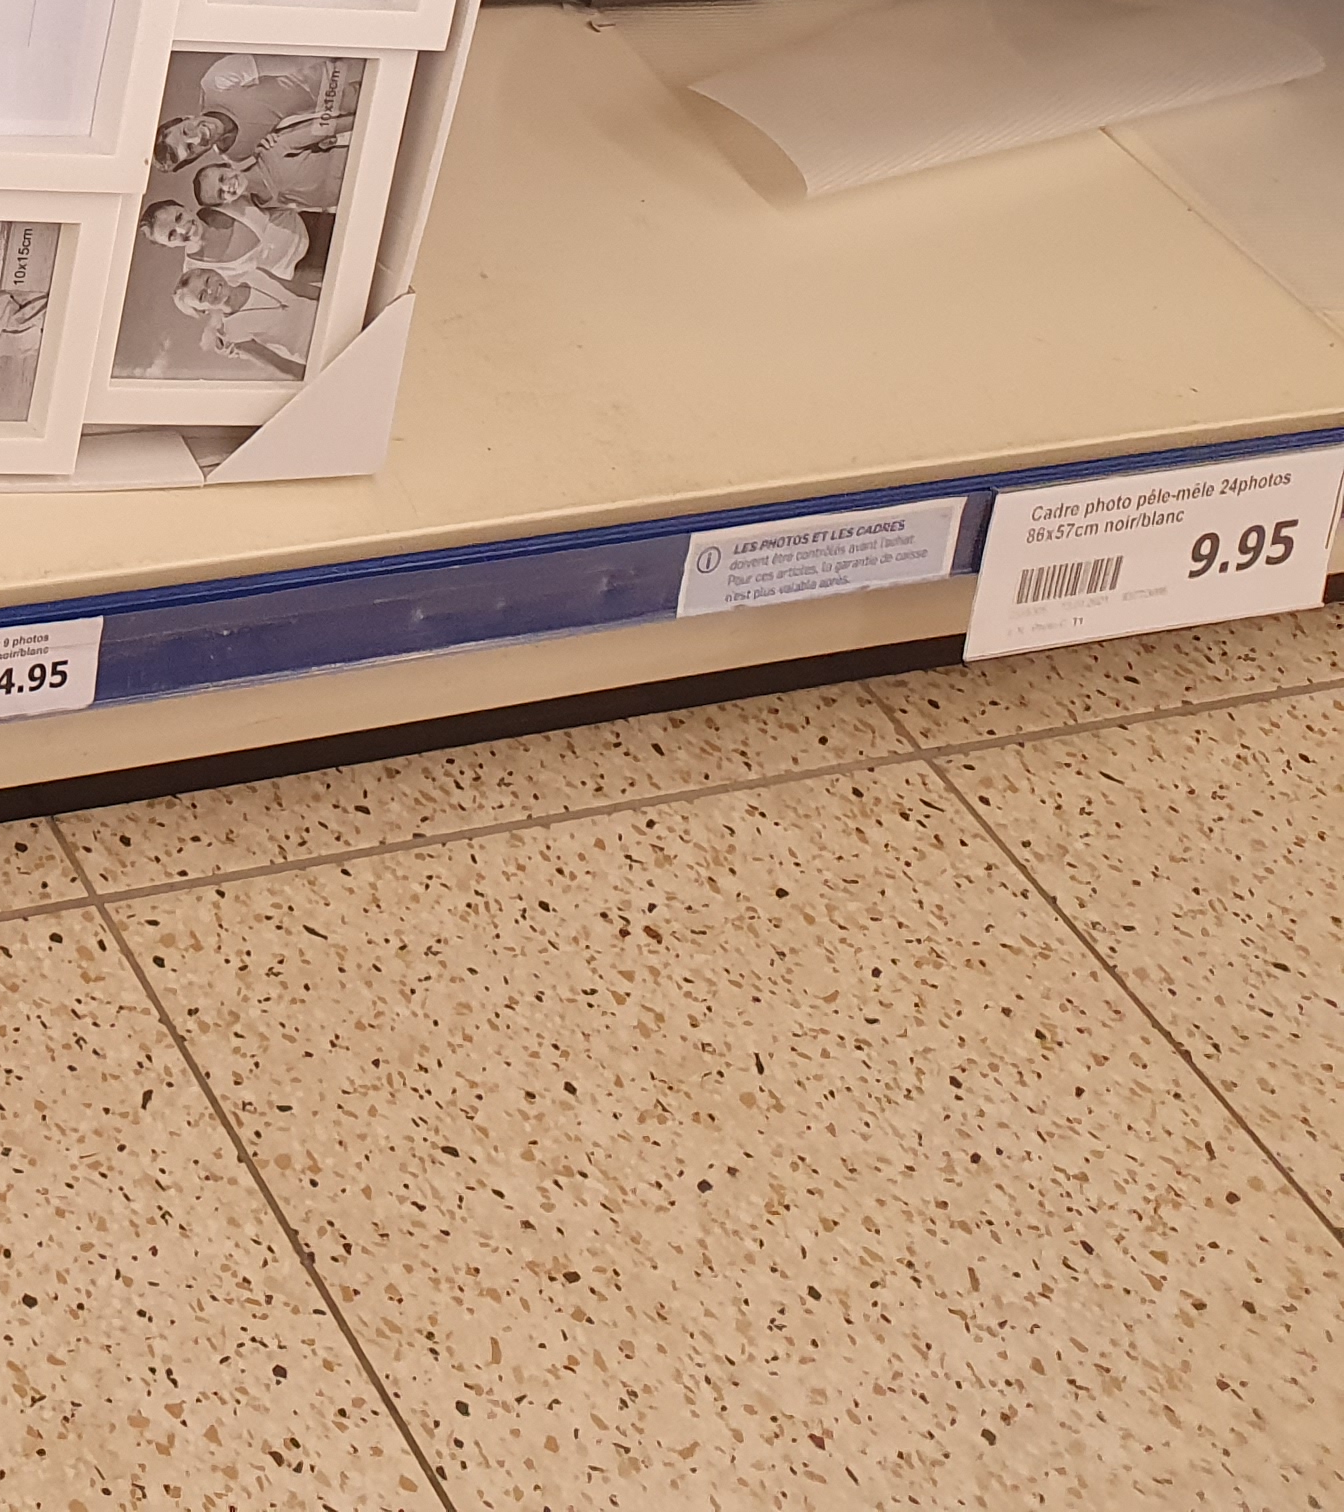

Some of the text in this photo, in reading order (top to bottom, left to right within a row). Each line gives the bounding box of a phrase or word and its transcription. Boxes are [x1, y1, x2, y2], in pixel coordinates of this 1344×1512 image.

[319, 68, 341, 129] 10x15cm
[13, 227, 33, 286] 10x15cm
[1032, 471, 1292, 521] Cadre photo pêle-mêle 24photos
[733, 519, 905, 555] LES PHOTOS ET LES CADRES
[1027, 509, 1185, 543] 86x57cm noir/blanc
[1188, 519, 1299, 579] 9.95
[3, 638, 10, 648] 9
[12, 634, 49, 648] photos
